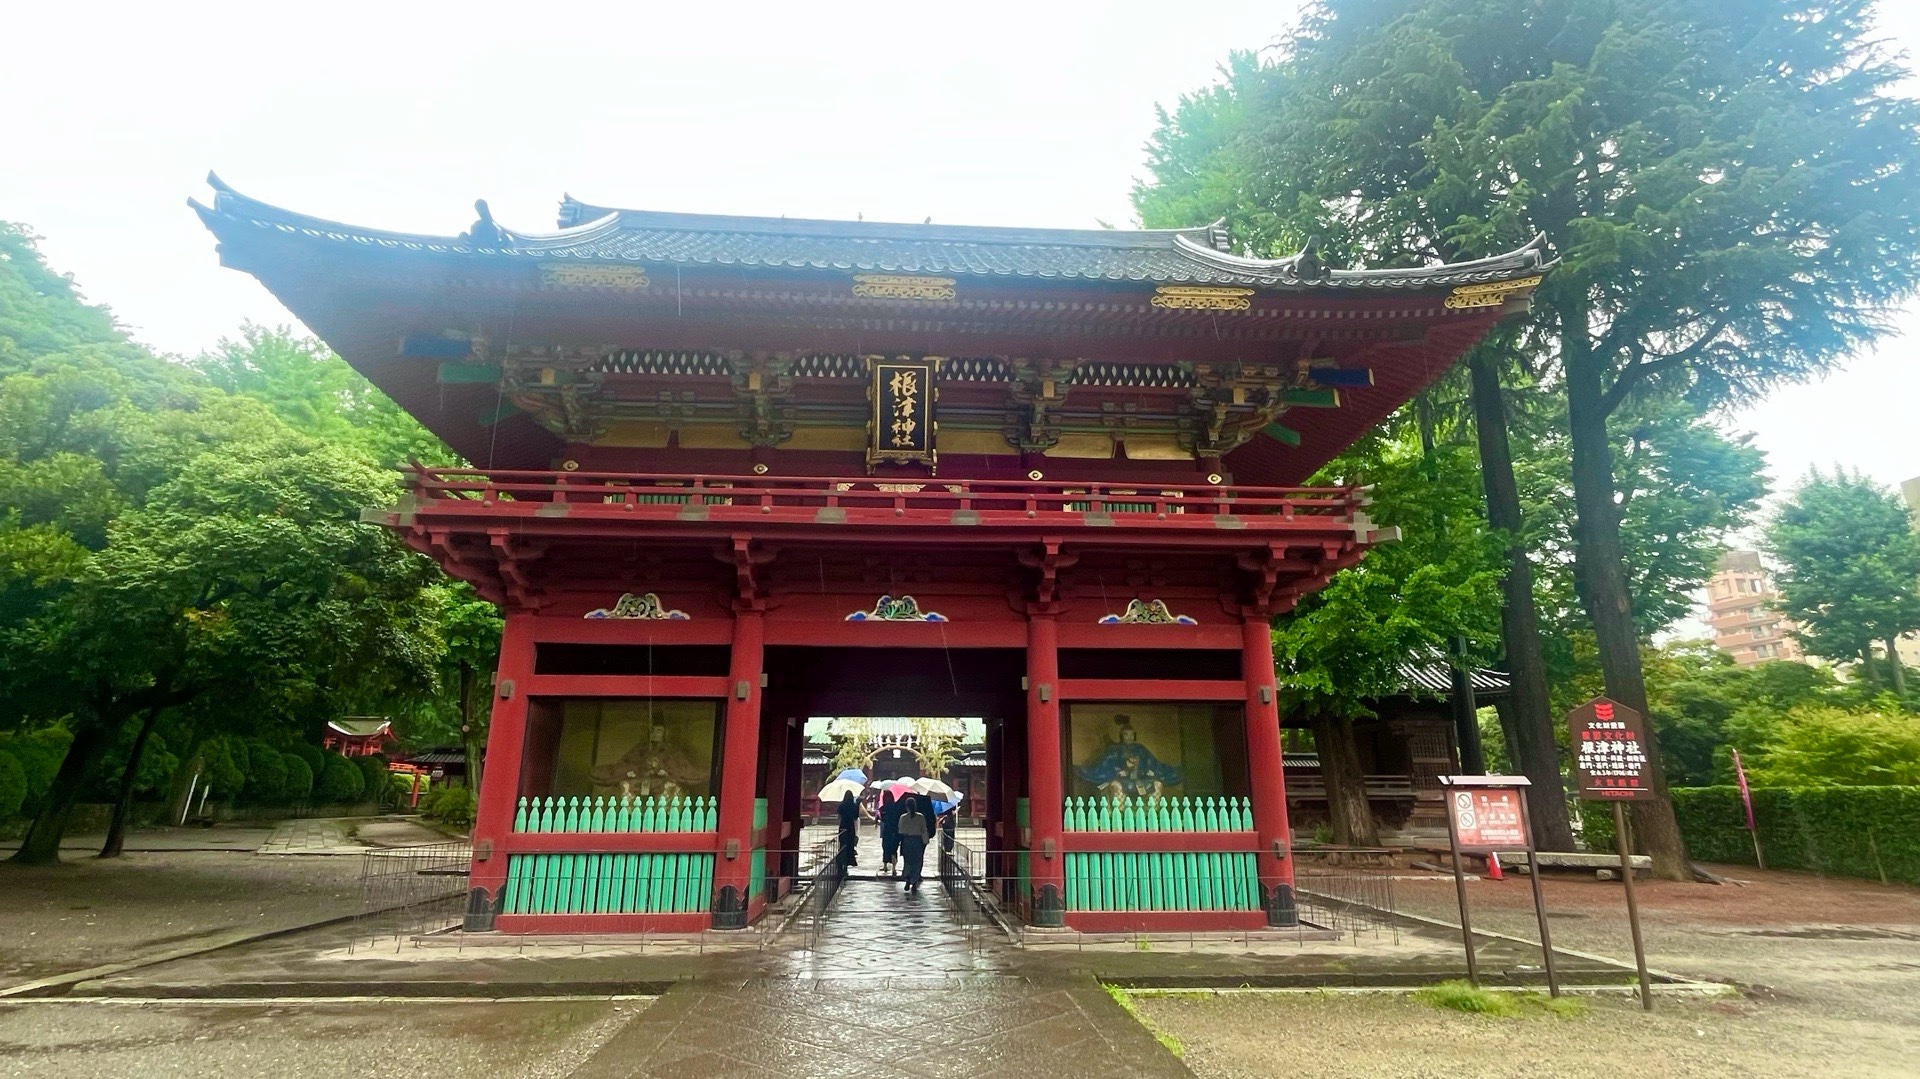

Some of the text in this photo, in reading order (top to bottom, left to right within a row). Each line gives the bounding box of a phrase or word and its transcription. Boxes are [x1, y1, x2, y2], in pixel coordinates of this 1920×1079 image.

[889, 371, 918, 447] 根津神社
[1580, 741, 1642, 754] 根津神社
